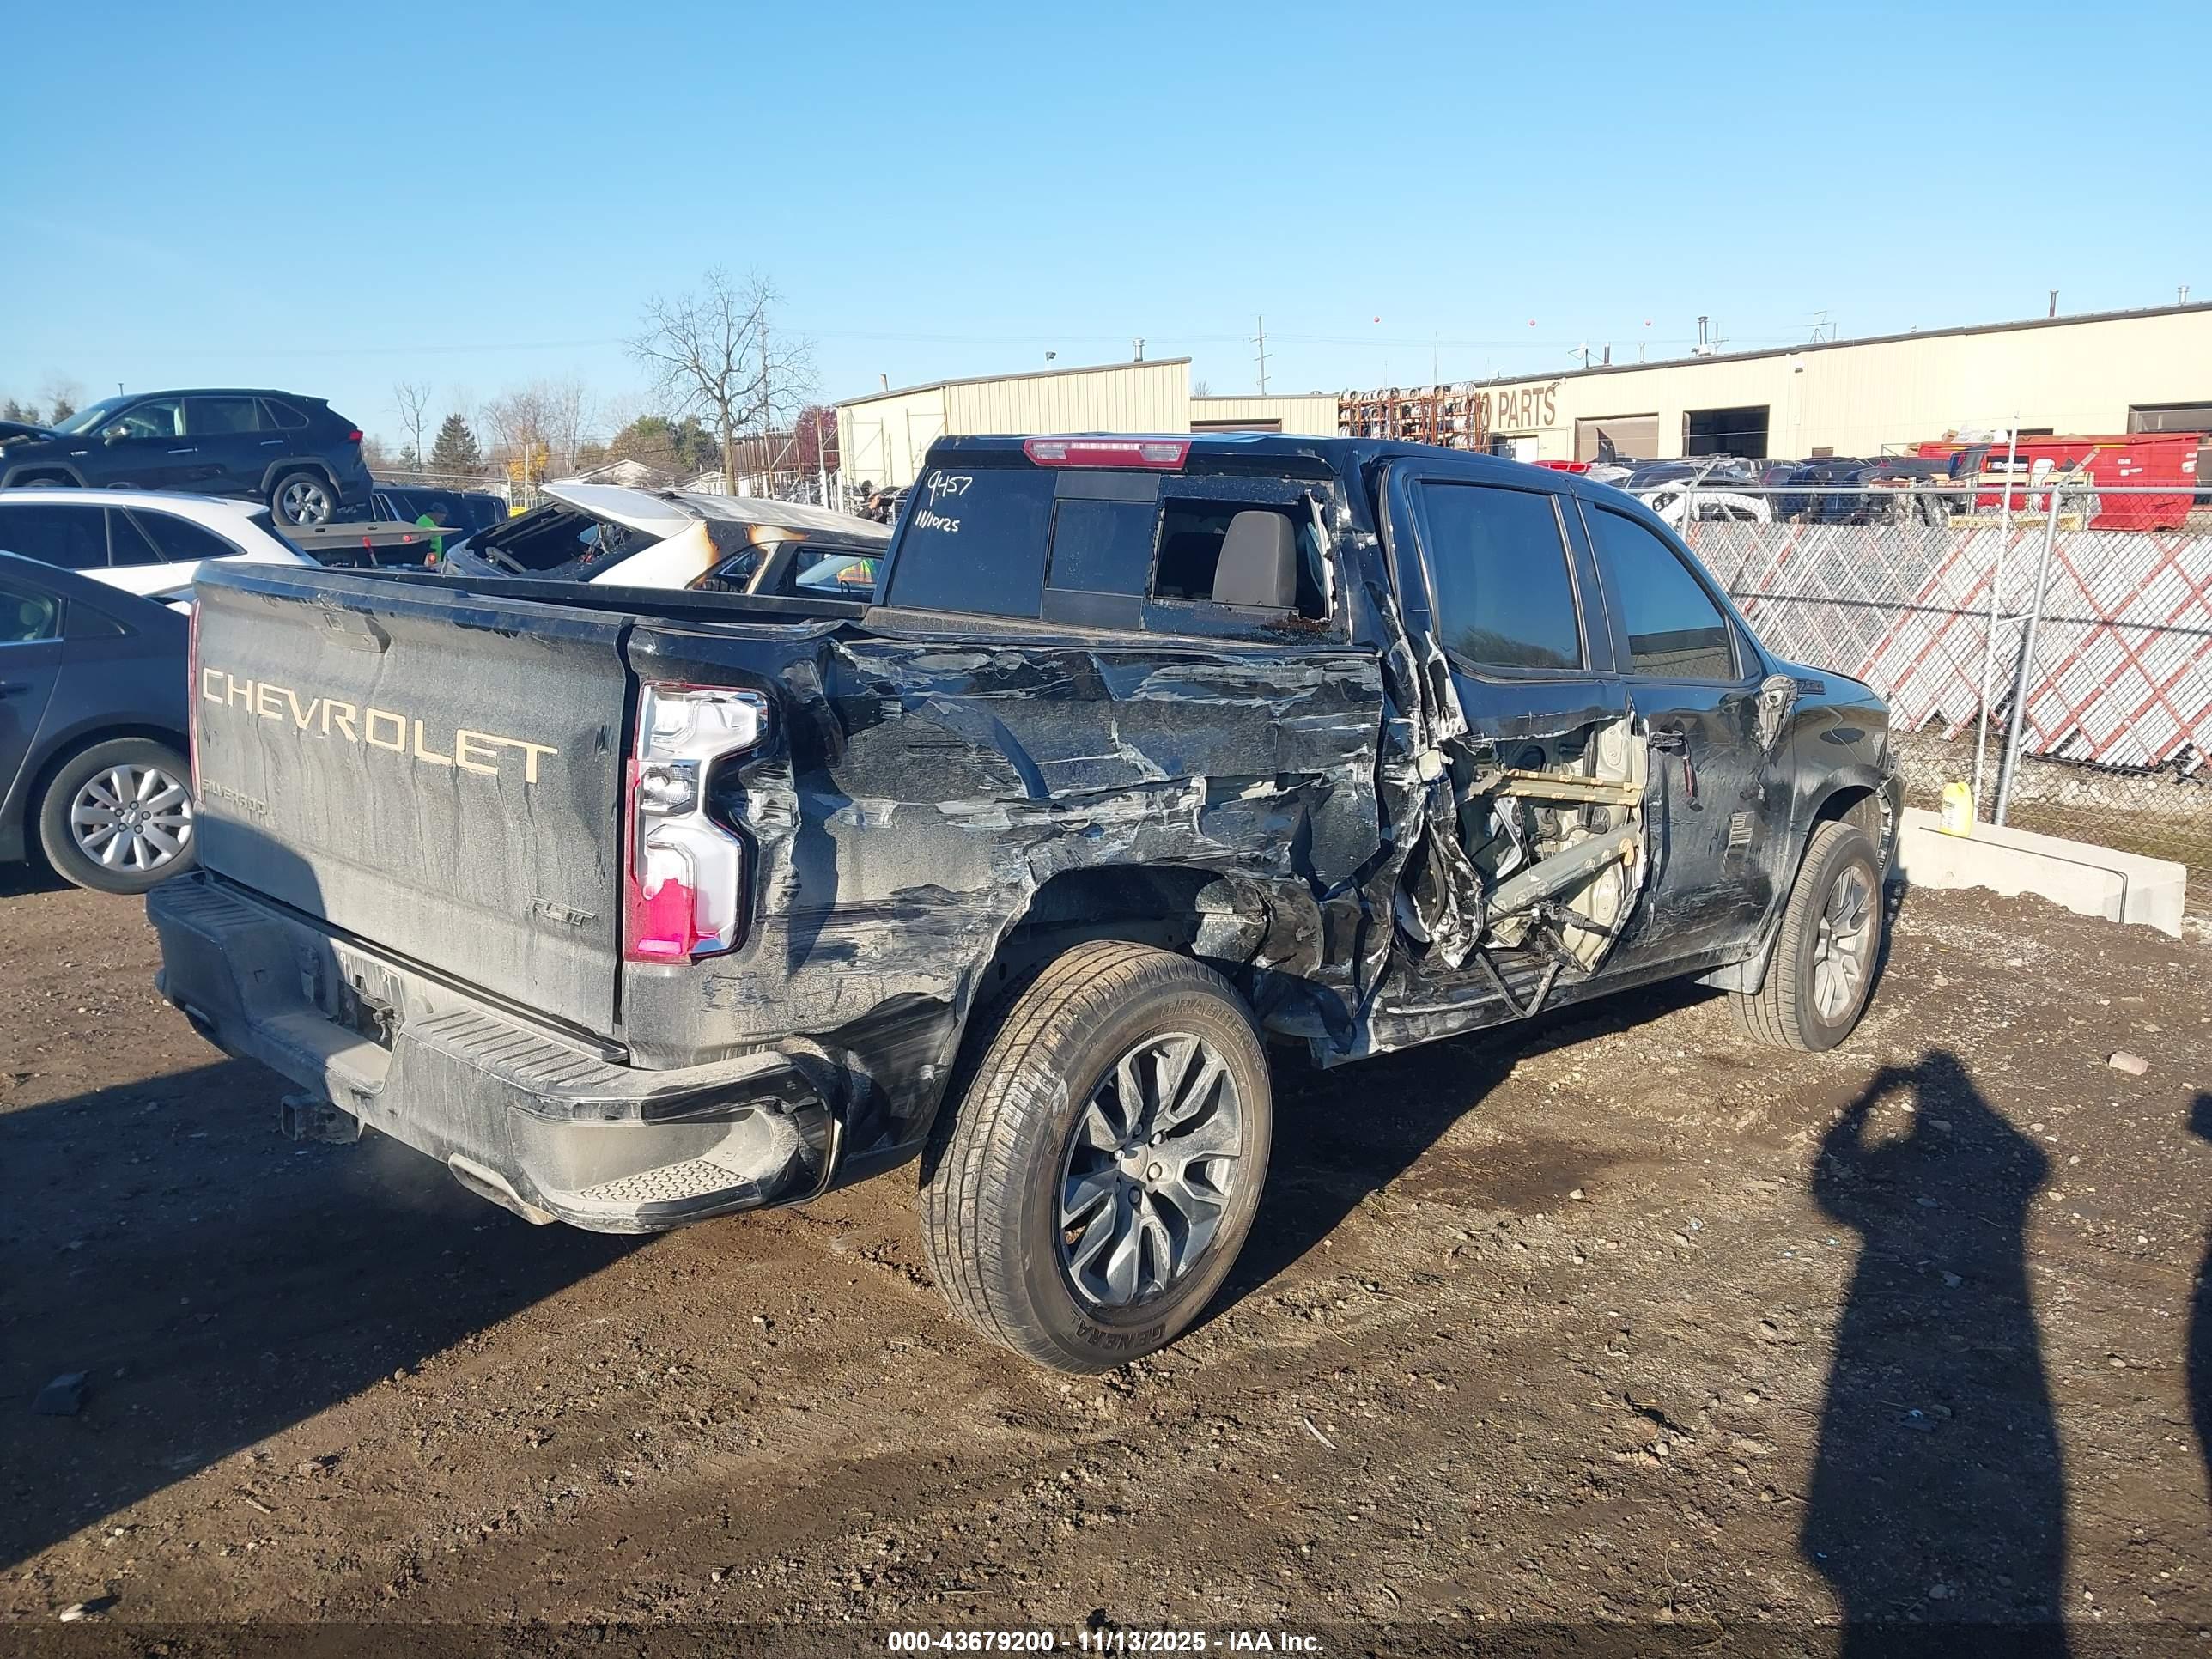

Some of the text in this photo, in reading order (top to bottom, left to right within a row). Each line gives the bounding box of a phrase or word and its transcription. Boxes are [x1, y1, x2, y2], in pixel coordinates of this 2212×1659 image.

[1498, 386, 1557, 428] PARTS
[927, 470, 973, 507] 9457
[915, 509, 960, 532] 11/10/25
[203, 667, 559, 785] CHEVROLET
[202, 778, 268, 815] SILVERADO
[1069, 1307, 1168, 1352] GENERAL
